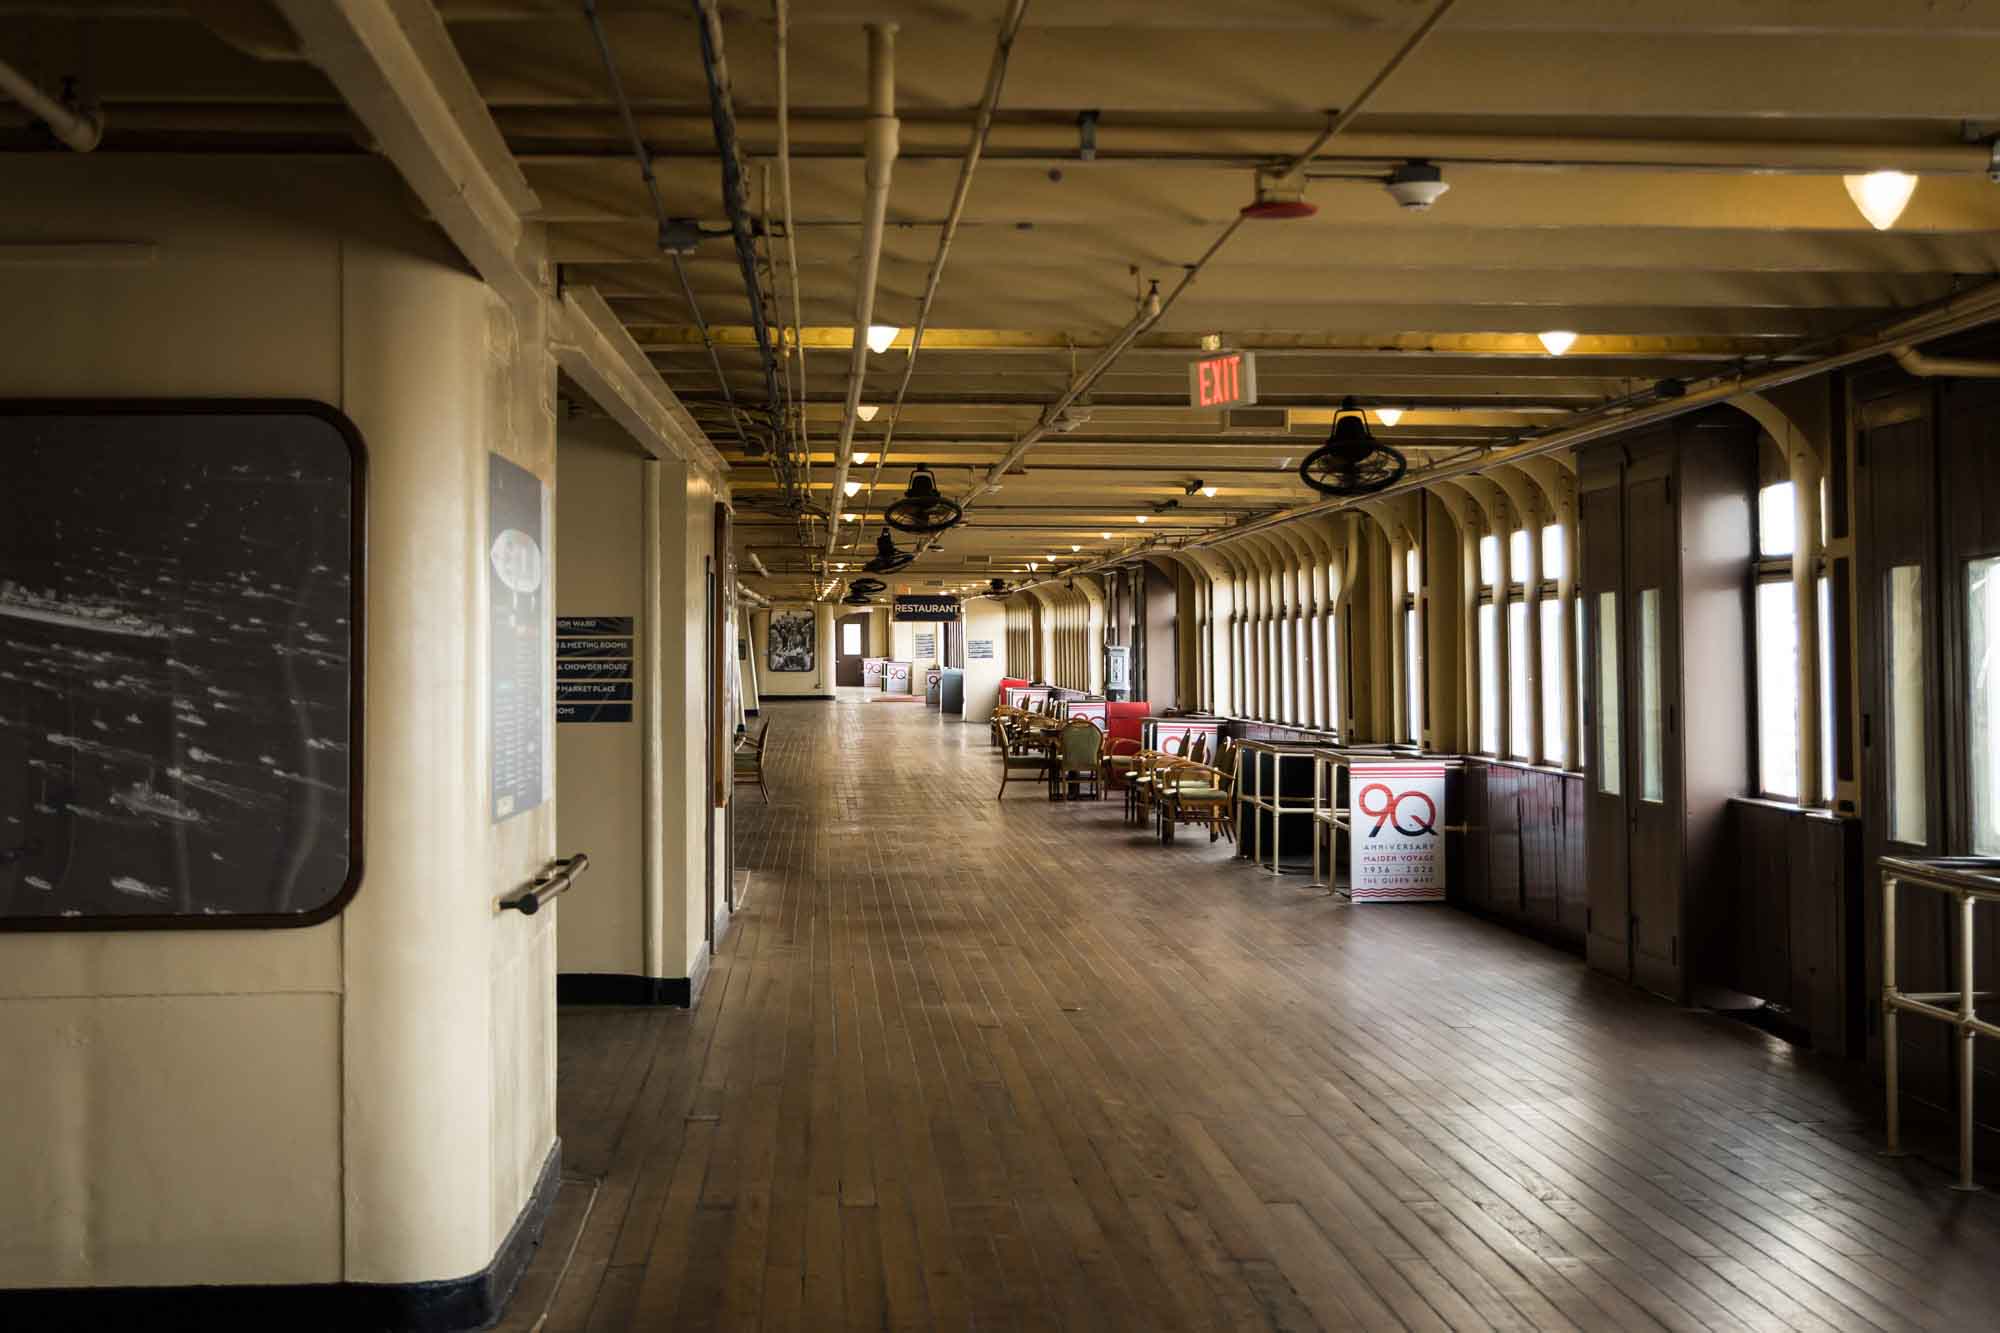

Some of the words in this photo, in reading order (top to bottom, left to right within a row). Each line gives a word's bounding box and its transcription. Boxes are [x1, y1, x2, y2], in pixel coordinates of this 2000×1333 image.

[1199, 356, 1241, 408] EXIT
[894, 604, 960, 613] RESTAURANT
[567, 641, 599, 649] MEETING
[600, 641, 628, 649] ROOMS
[564, 663, 602, 671] CHOWDER
[602, 663, 628, 671] HOUSE
[561, 685, 592, 693] MARKET
[1362, 843, 1435, 851] ANNIVERSARY
